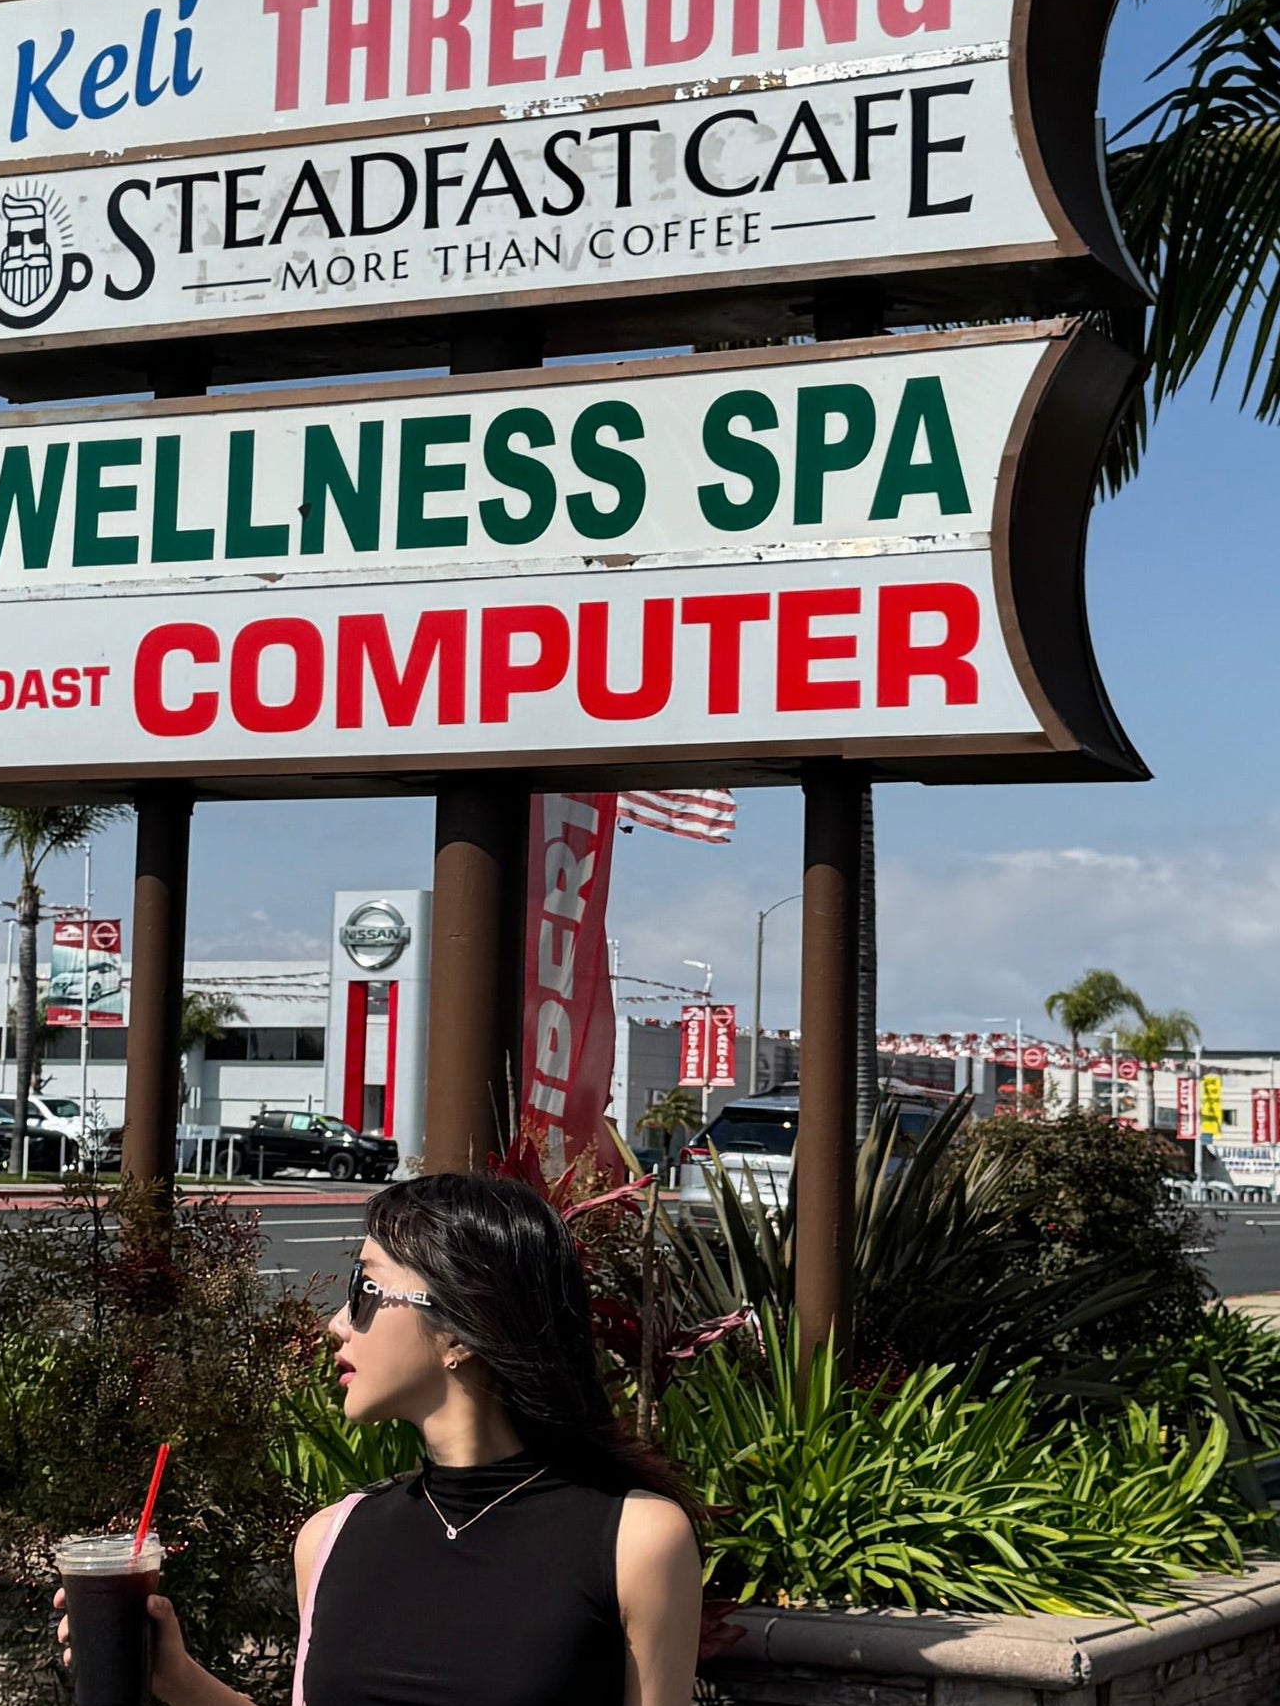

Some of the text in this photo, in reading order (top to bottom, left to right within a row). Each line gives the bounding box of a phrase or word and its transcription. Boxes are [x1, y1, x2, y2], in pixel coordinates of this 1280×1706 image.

[104, 79, 974, 301] STEADFAST CAFE
[279, 210, 762, 293] MORE THAN COFFEE
[695, 374, 972, 535] SPA
[134, 582, 980, 738] COMPUTER
[344, 929, 400, 940] NISSAN
